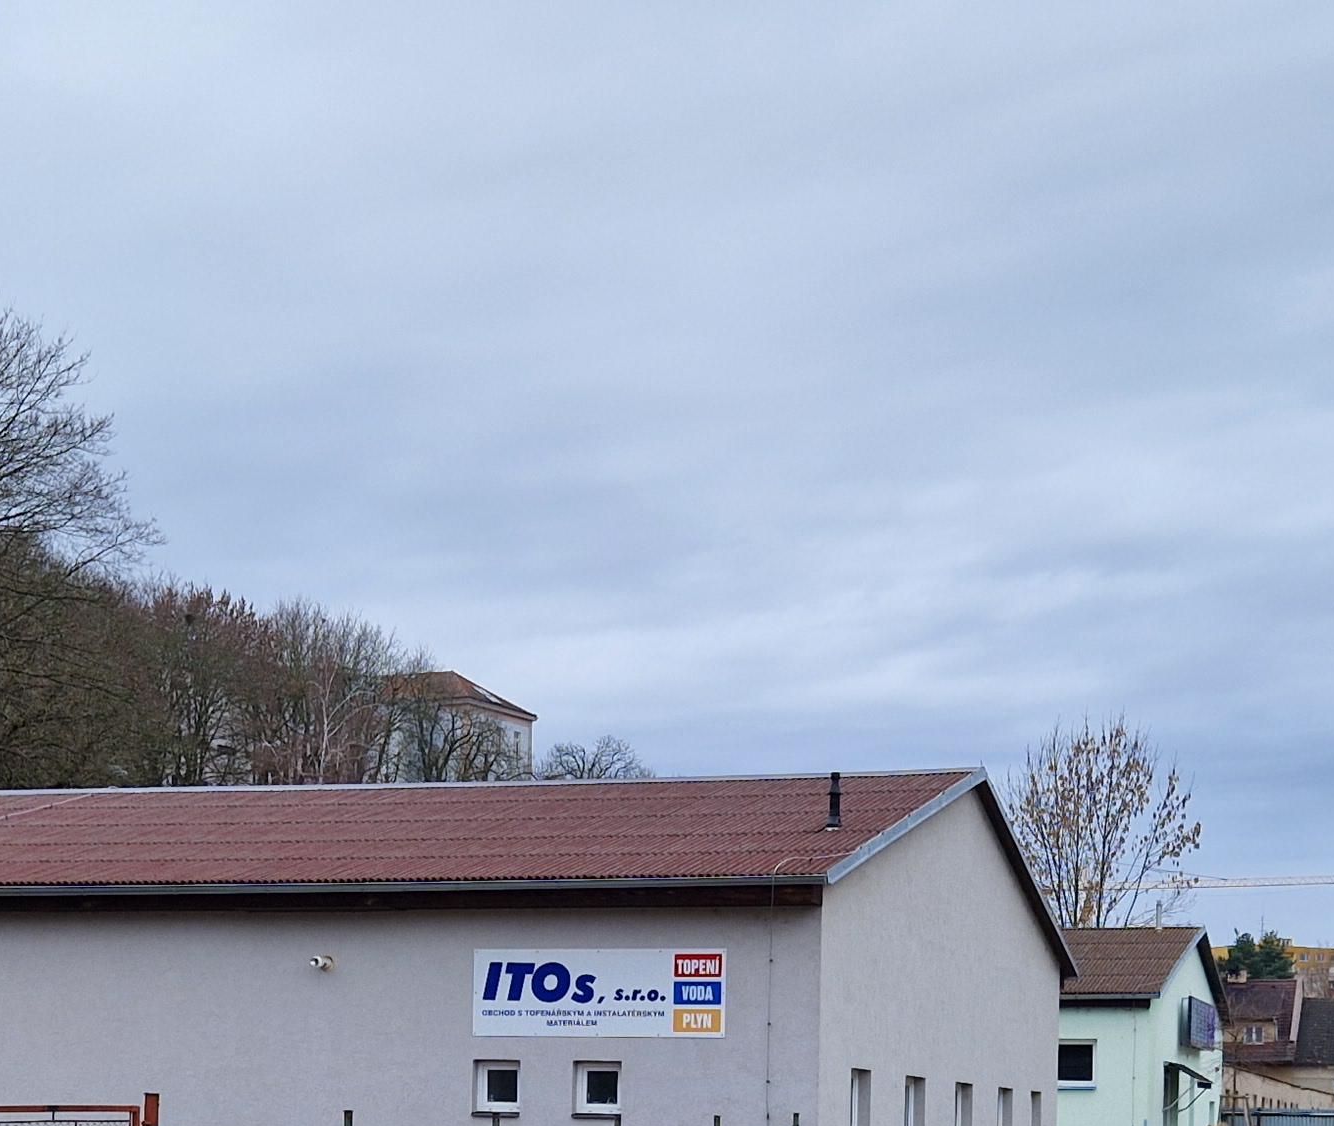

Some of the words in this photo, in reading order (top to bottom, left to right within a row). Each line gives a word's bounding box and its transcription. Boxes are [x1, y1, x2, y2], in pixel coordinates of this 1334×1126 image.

[676, 955, 720, 975] TOPENÍ
[613, 988, 667, 1001] s.r.o.
[682, 985, 714, 1002] VODA
[481, 1009, 516, 1017] OBCHOD
[517, 1009, 523, 1017] S
[586, 1009, 592, 1017] A
[546, 1018, 598, 1027] MATERIÁLEM
[682, 1013, 713, 1029] PLYN
